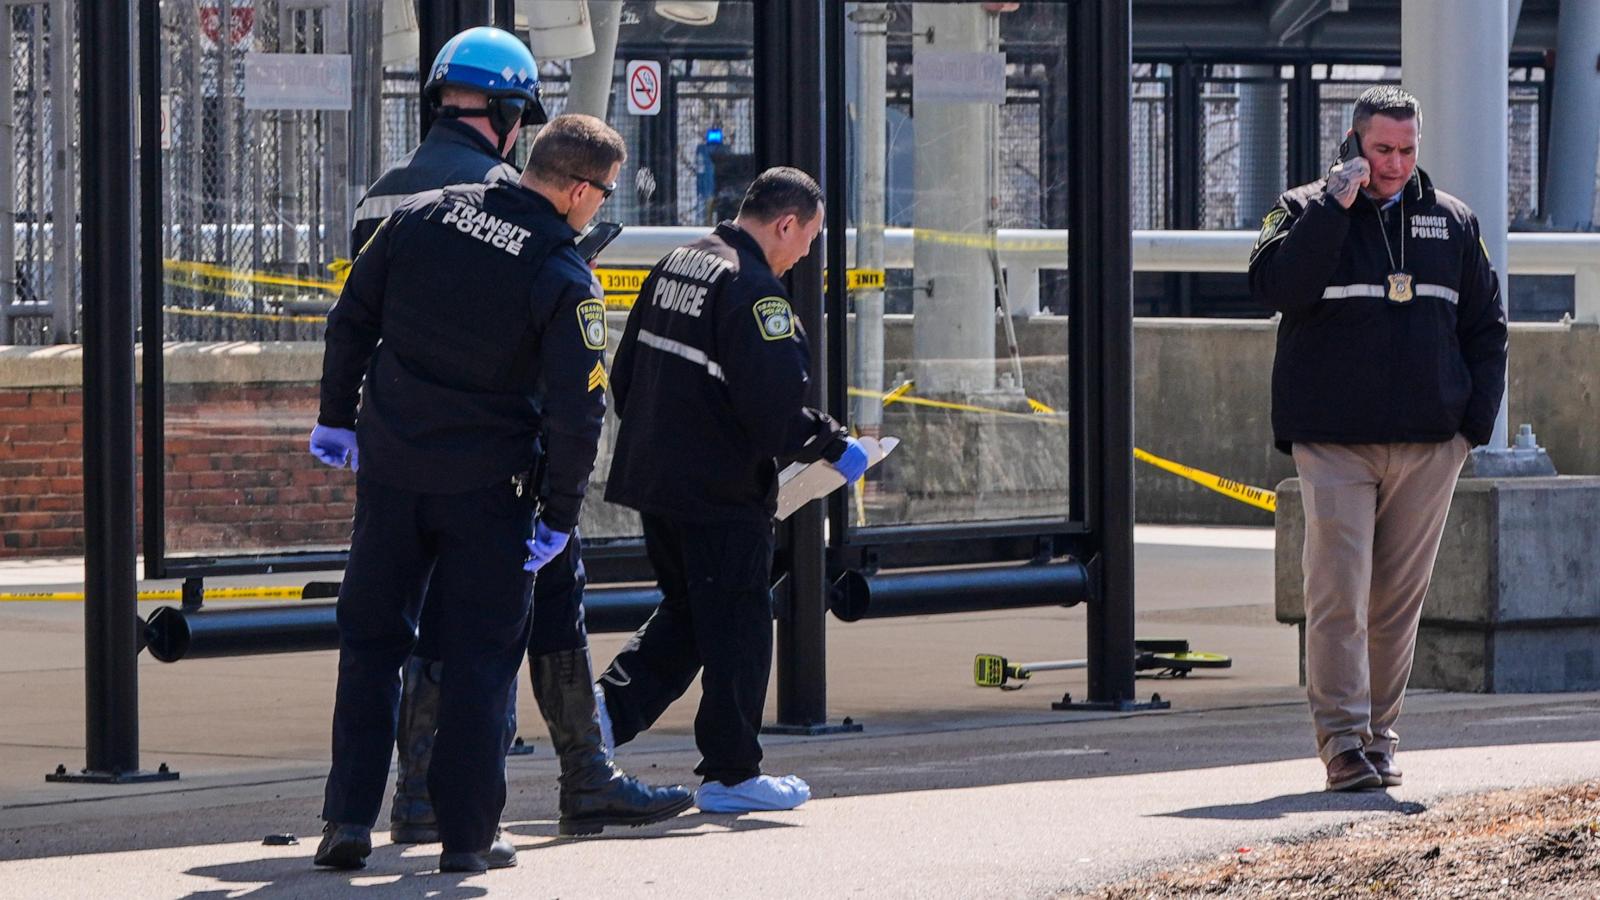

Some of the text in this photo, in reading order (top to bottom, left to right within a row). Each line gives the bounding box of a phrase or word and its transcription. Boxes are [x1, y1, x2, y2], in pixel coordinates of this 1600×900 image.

[452, 201, 531, 243] TRANSIT
[1410, 215, 1447, 227] TRANSIT
[442, 212, 523, 256] POLICE
[1411, 227, 1449, 240] POLICE
[662, 247, 734, 284] TRANSIT
[608, 274, 646, 288] OLICE
[855, 274, 879, 285] LINE
[1217, 477, 1263, 501] BOSTON
